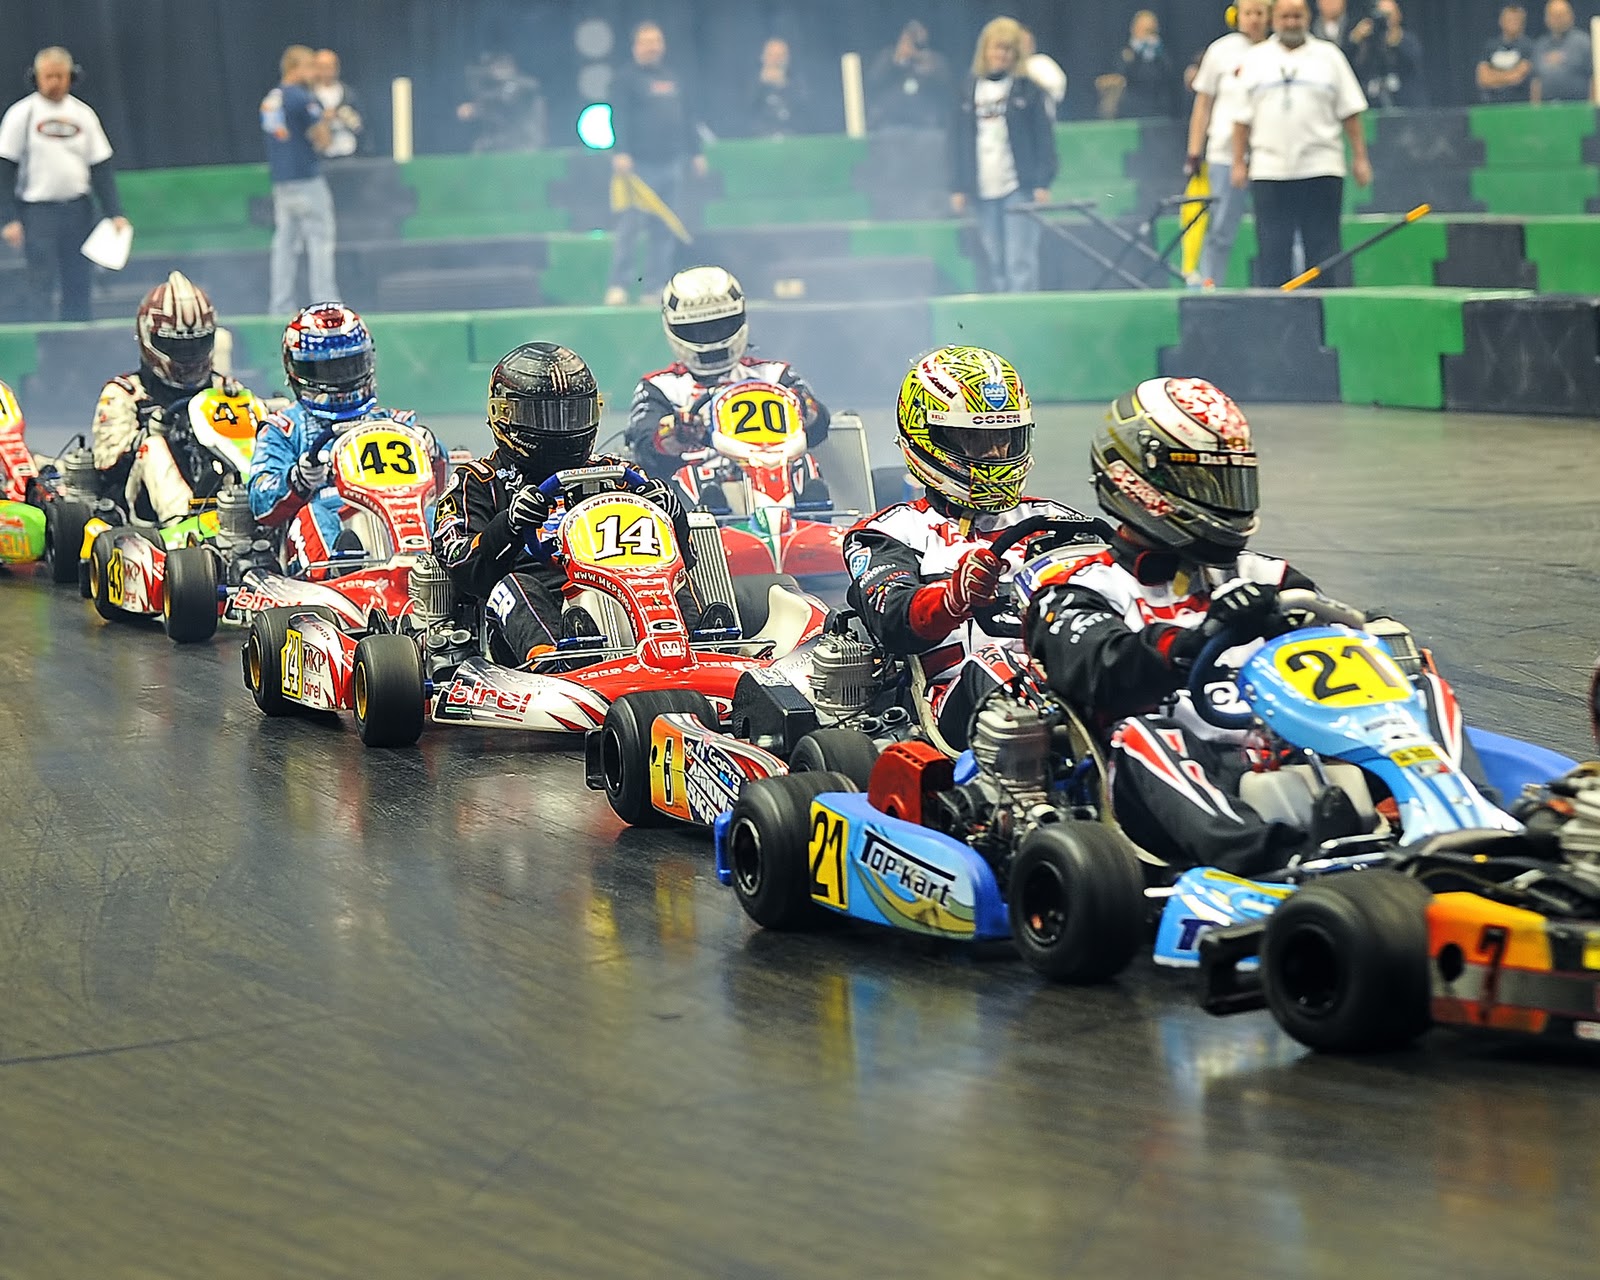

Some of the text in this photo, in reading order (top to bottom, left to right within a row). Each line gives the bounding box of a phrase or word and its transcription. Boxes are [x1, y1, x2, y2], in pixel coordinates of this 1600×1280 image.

[731, 399, 787, 435] 20
[972, 413, 1021, 426] OGDEN
[358, 440, 417, 475] 43
[594, 514, 661, 562] 14
[109, 551, 123, 600] 43
[282, 633, 300, 695] 14
[1286, 645, 1400, 701] 21
[304, 676, 321, 700] birel
[446, 680, 532, 714] birel
[708, 748, 742, 787] GoPro
[810, 811, 846, 905] 21
[1478, 924, 1510, 1022] 7
